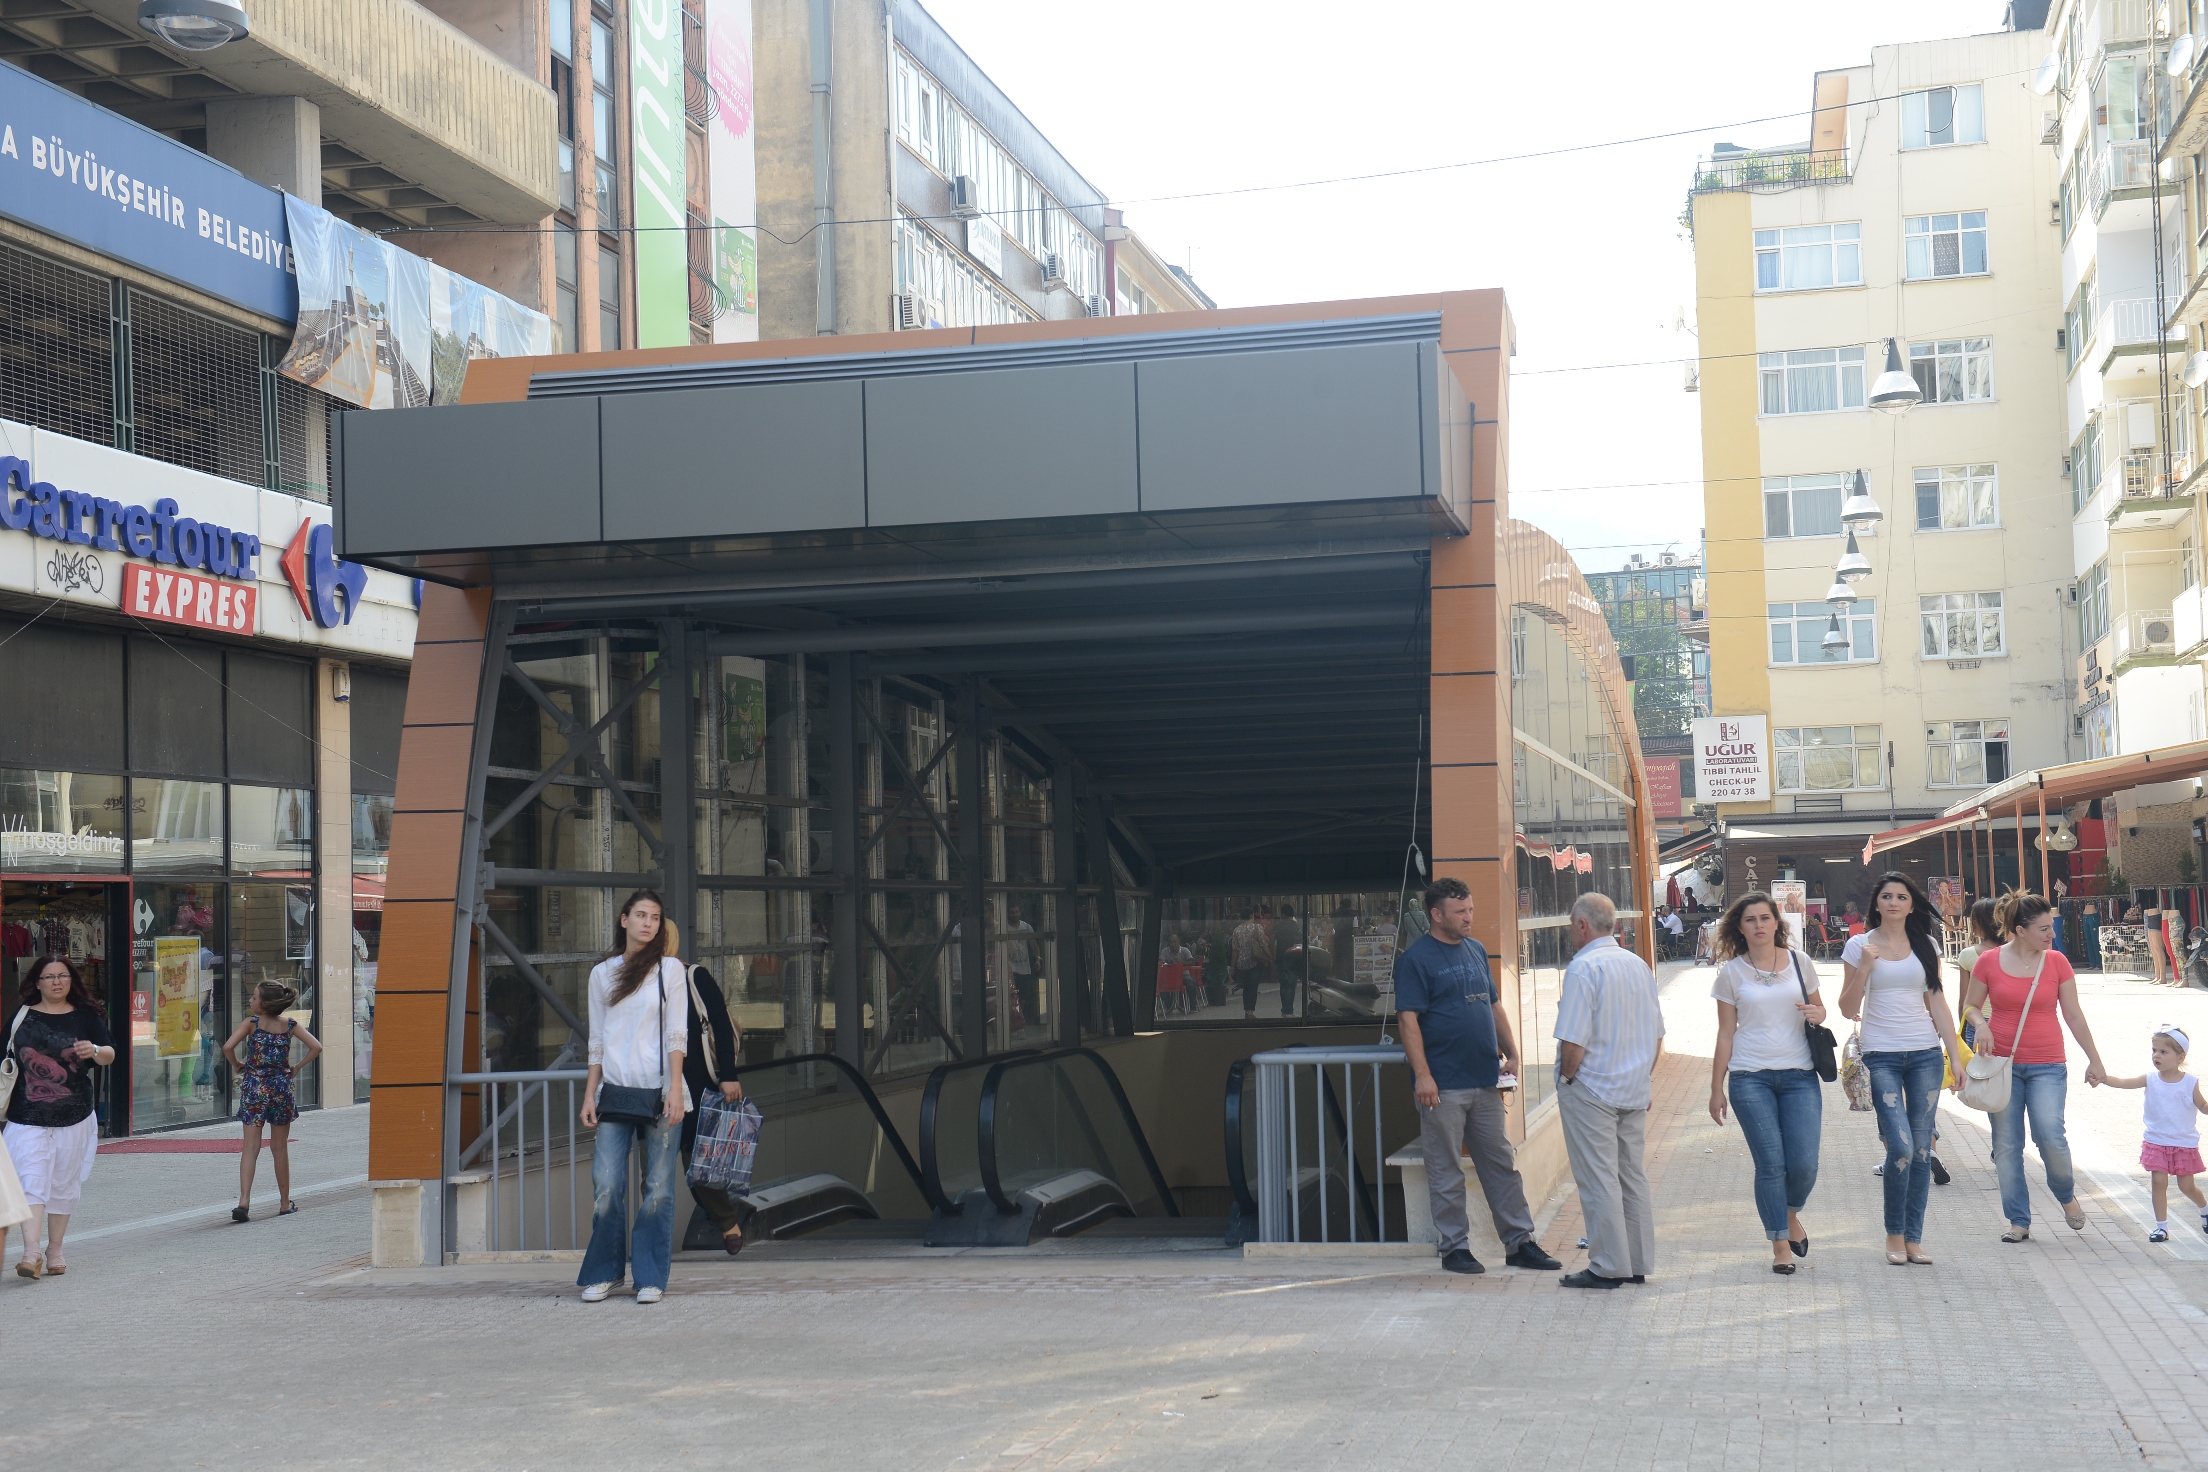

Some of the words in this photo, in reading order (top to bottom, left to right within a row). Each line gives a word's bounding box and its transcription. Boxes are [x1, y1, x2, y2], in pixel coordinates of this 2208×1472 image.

[1, 124, 18, 160] A
[31, 135, 186, 230] BÜYÜKŞEHİR
[198, 207, 296, 275] BELEDİYE
[0, 455, 261, 581] Carrefour
[135, 569, 247, 630] EXPRES
[1705, 743, 1756, 757] UĞUR
[1702, 766, 1727, 776] TIBBİ
[1729, 764, 1762, 774] TAHLİL
[1709, 777, 1757, 787] CHECK-UP
[1711, 789, 1728, 797] 220
[1730, 788, 1741, 796] 47
[1744, 787, 1755, 795] 38
[23, 825, 121, 856] hoşgeldiniz
[727, 1119, 737, 1138] I
[703, 1141, 751, 1159] LOVE
